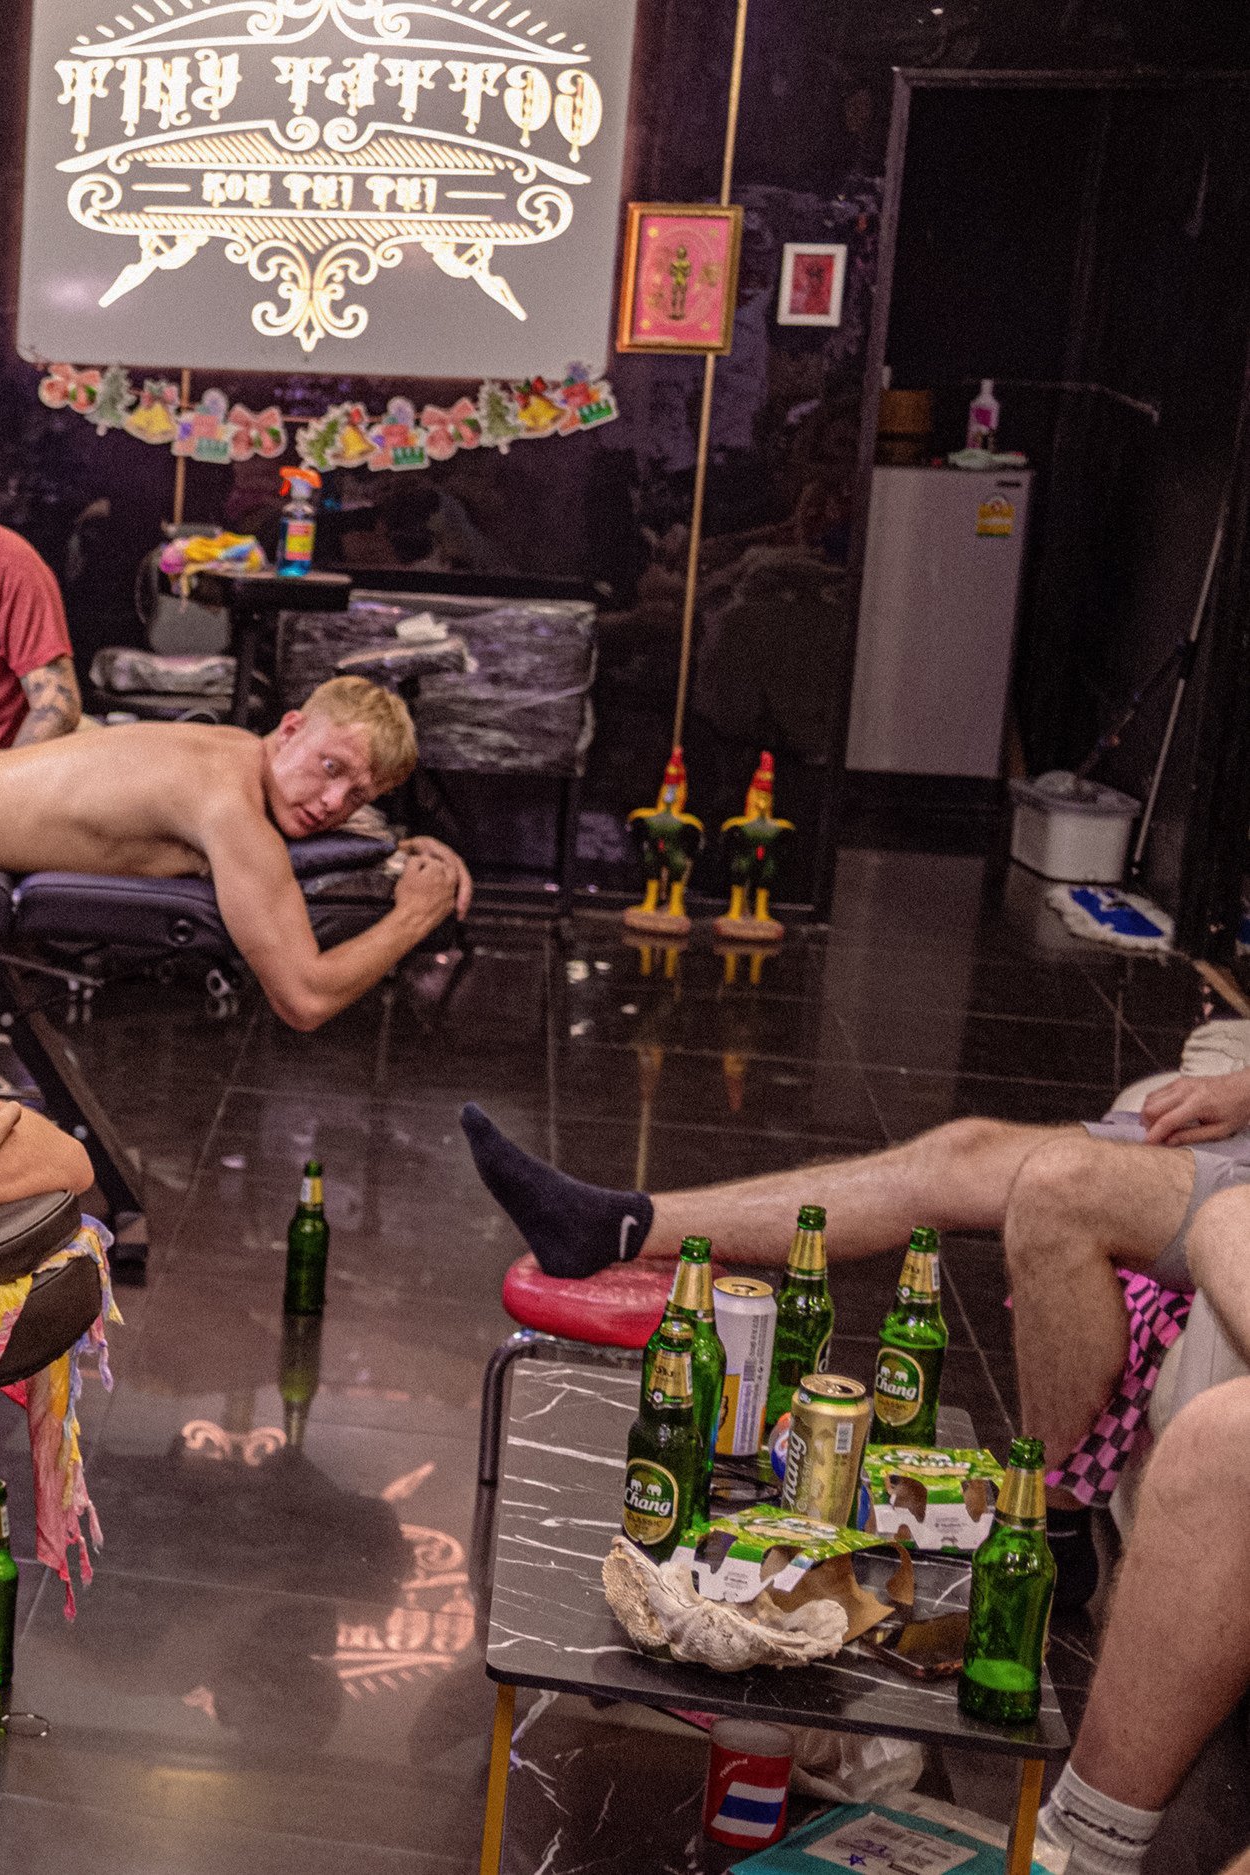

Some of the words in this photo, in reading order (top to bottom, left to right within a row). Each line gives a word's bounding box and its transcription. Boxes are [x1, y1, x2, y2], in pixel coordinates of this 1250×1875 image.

[54, 48, 243, 152] TINY
[270, 52, 603, 164] TATTOO
[202, 172, 272, 208] KOH
[282, 173, 354, 211] PHI
[365, 174, 438, 214] PHI
[874, 1373, 917, 1400] Chang
[624, 1487, 672, 1517] Chang
